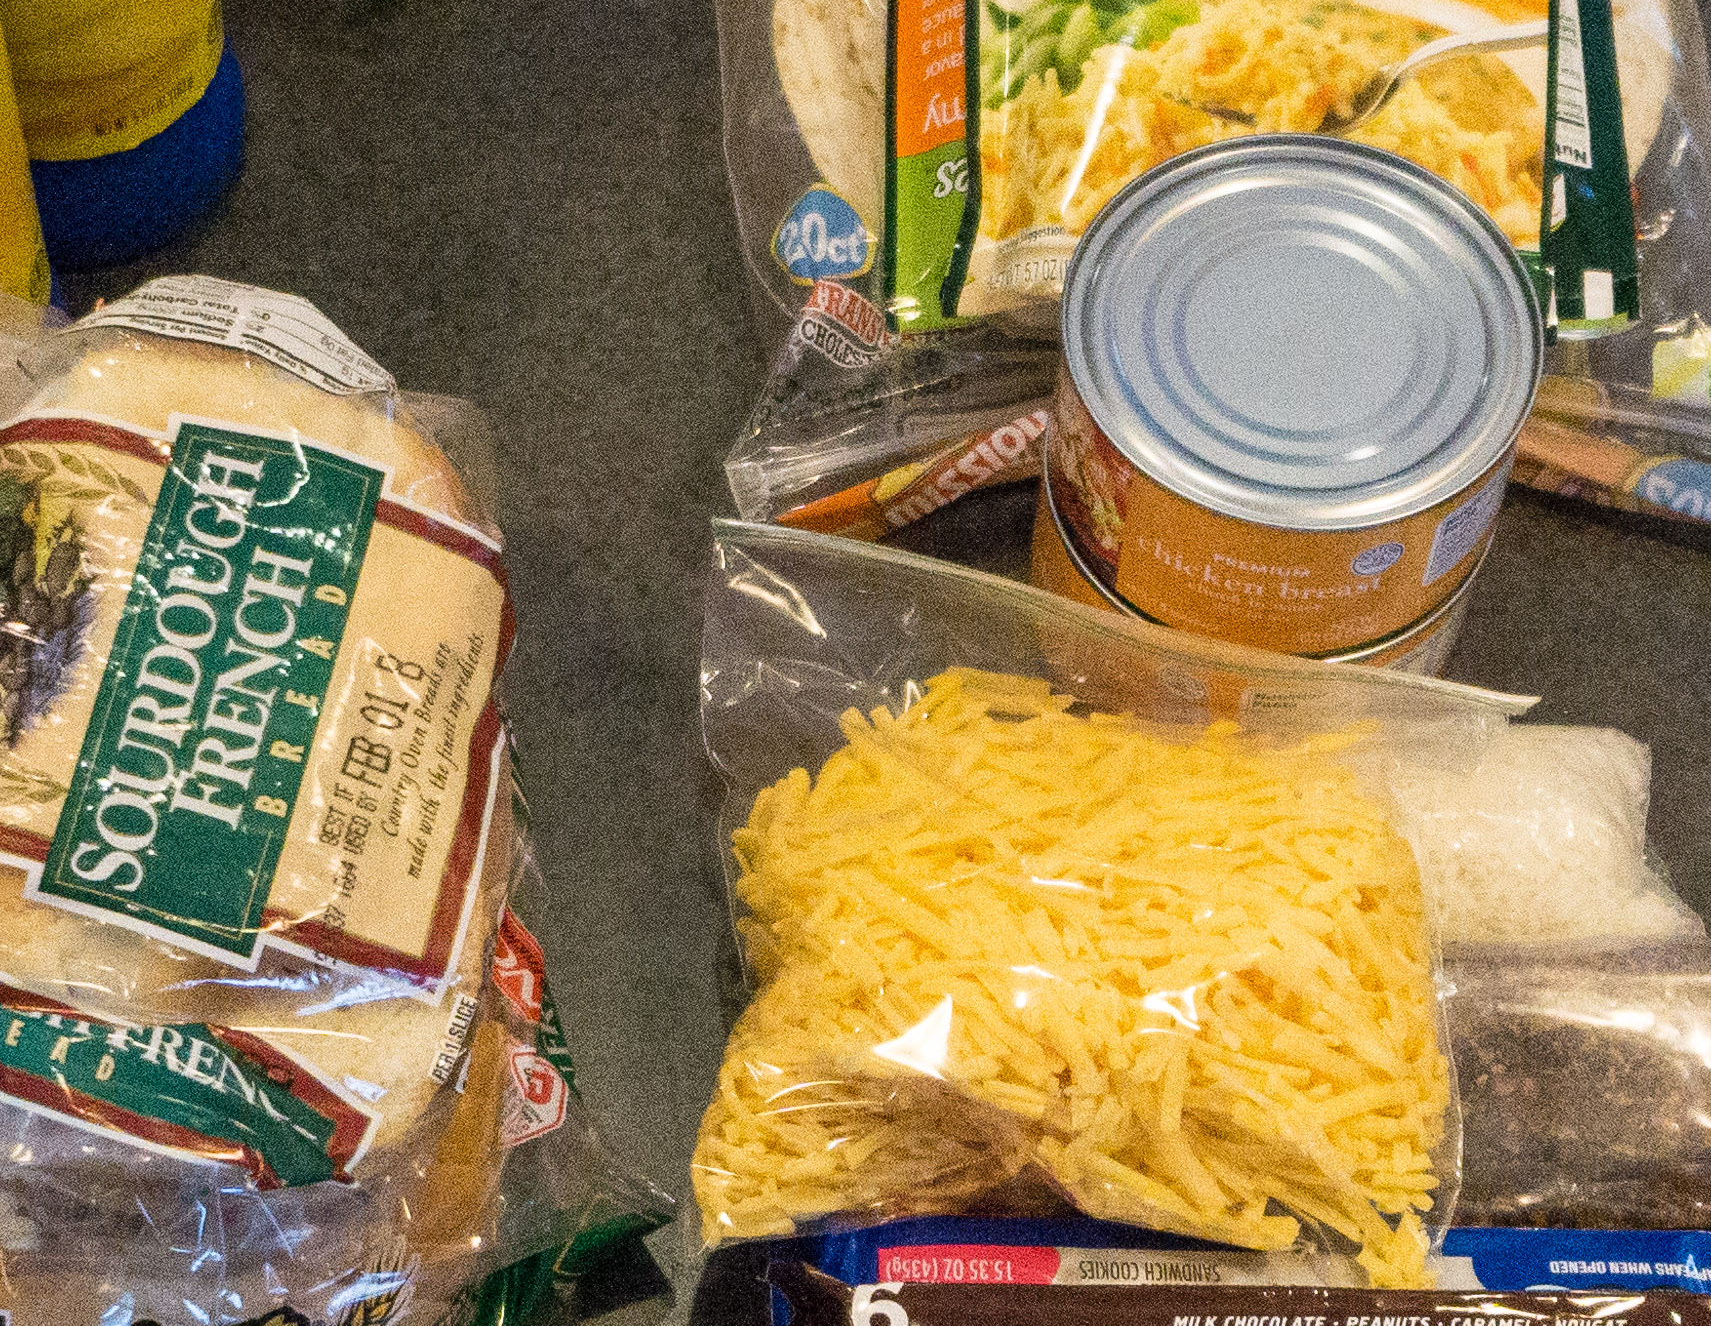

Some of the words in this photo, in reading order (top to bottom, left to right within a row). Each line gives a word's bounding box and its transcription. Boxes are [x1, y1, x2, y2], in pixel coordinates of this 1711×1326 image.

[68, 449, 266, 893] SOURDOUGH
[437, 640, 452, 669] are
[451, 631, 486, 717] ingredients.
[169, 544, 315, 832] FRENCH
[253, 583, 349, 819] BREAD
[413, 672, 444, 728] Breads
[359, 689, 410, 730] 01
[341, 735, 393, 789] FEB
[399, 730, 428, 769] Oven
[438, 715, 463, 773] finest
[427, 763, 450, 792] the
[318, 805, 343, 847] BEST
[333, 782, 355, 804] IF
[381, 775, 419, 838] Country
[420, 793, 443, 832] with
[406, 835, 429, 880] made
[431, 1050, 455, 1083] PER
[448, 998, 478, 1042] SLICE
[886, 1257, 939, 1283] (435g)
[943, 1258, 967, 1280] OZ
[968, 1260, 1014, 1282] 15.35
[1079, 1260, 1140, 1283] COOKIES
[1143, 1260, 1222, 1284] SANDWICH
[1548, 1259, 1605, 1274] OPENED
[1607, 1260, 1650, 1276] WHEN
